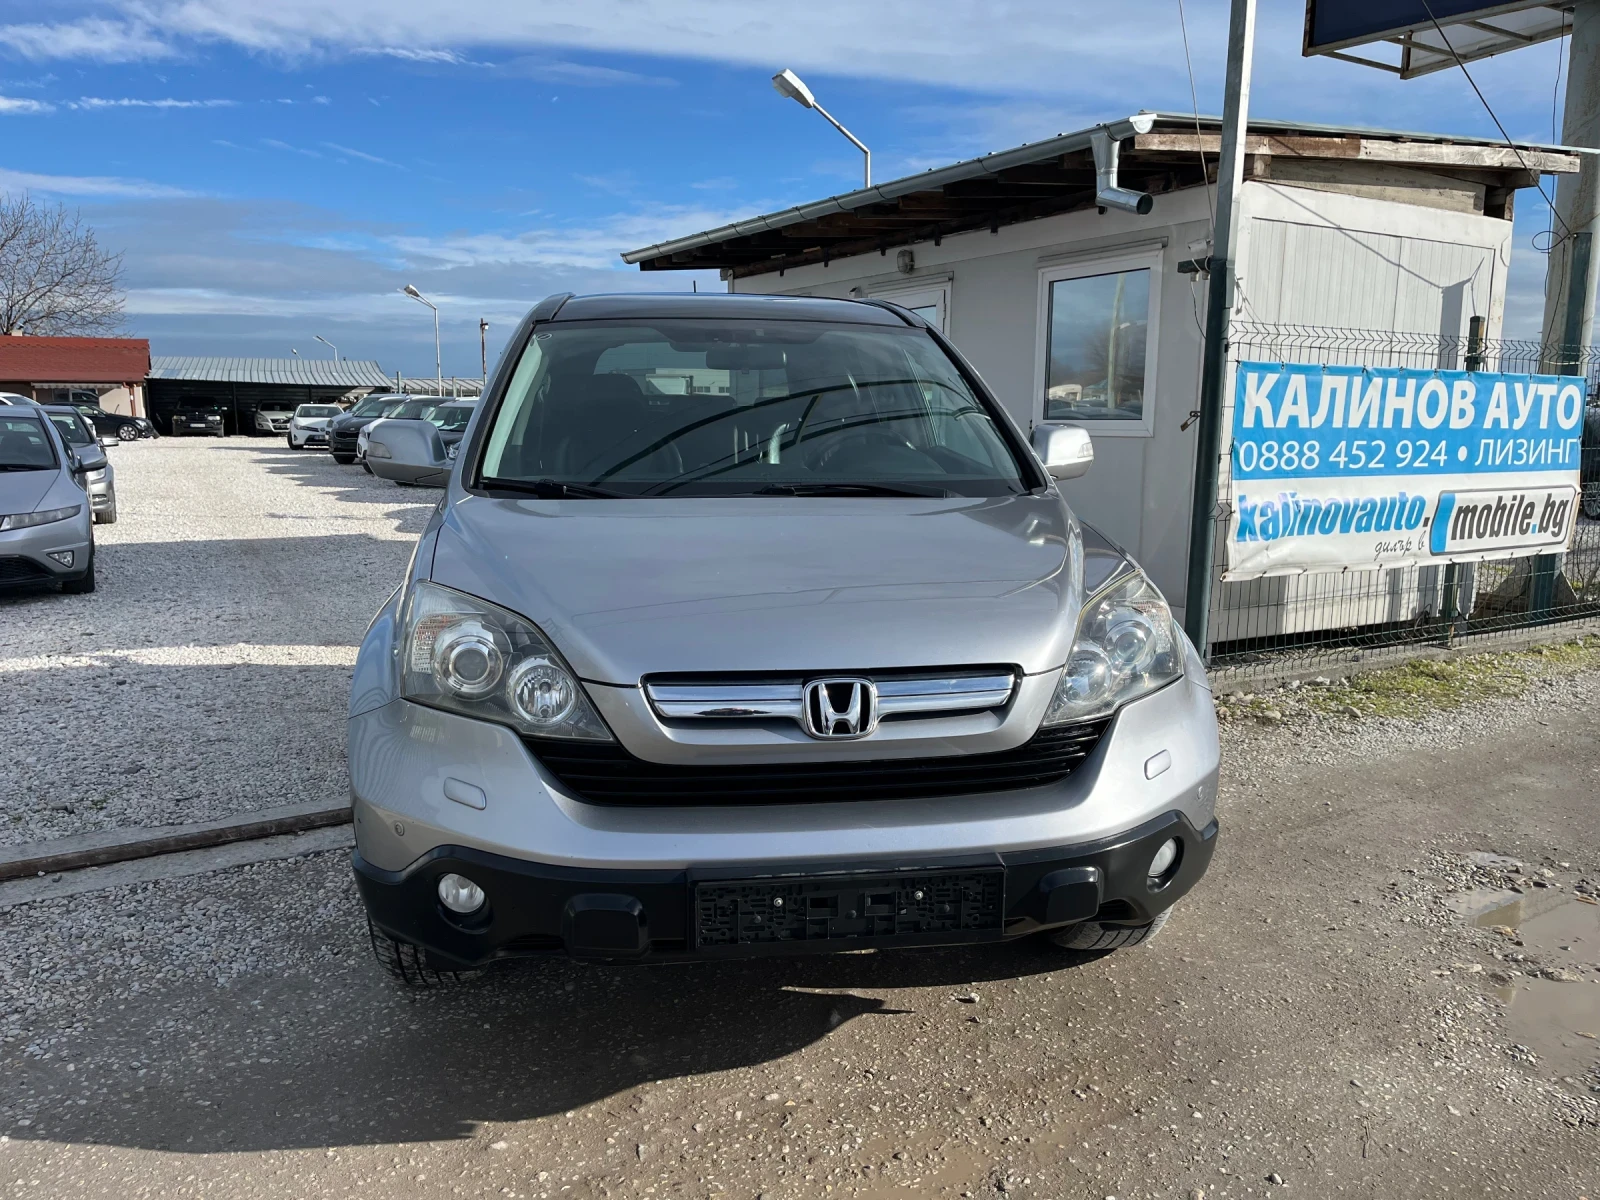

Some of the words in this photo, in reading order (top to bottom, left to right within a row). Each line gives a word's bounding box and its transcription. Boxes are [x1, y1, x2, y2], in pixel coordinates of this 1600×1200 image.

[1242, 372, 1477, 430] КАЛИНОВ
[1483, 382, 1581, 431] АУТО
[1239, 440, 1320, 471] 0888
[1329, 440, 1385, 469] 452
[1395, 440, 1448, 468] 924
[1475, 438, 1578, 466] ЛИЗИНГ
[1450, 493, 1569, 541] mobile.bg
